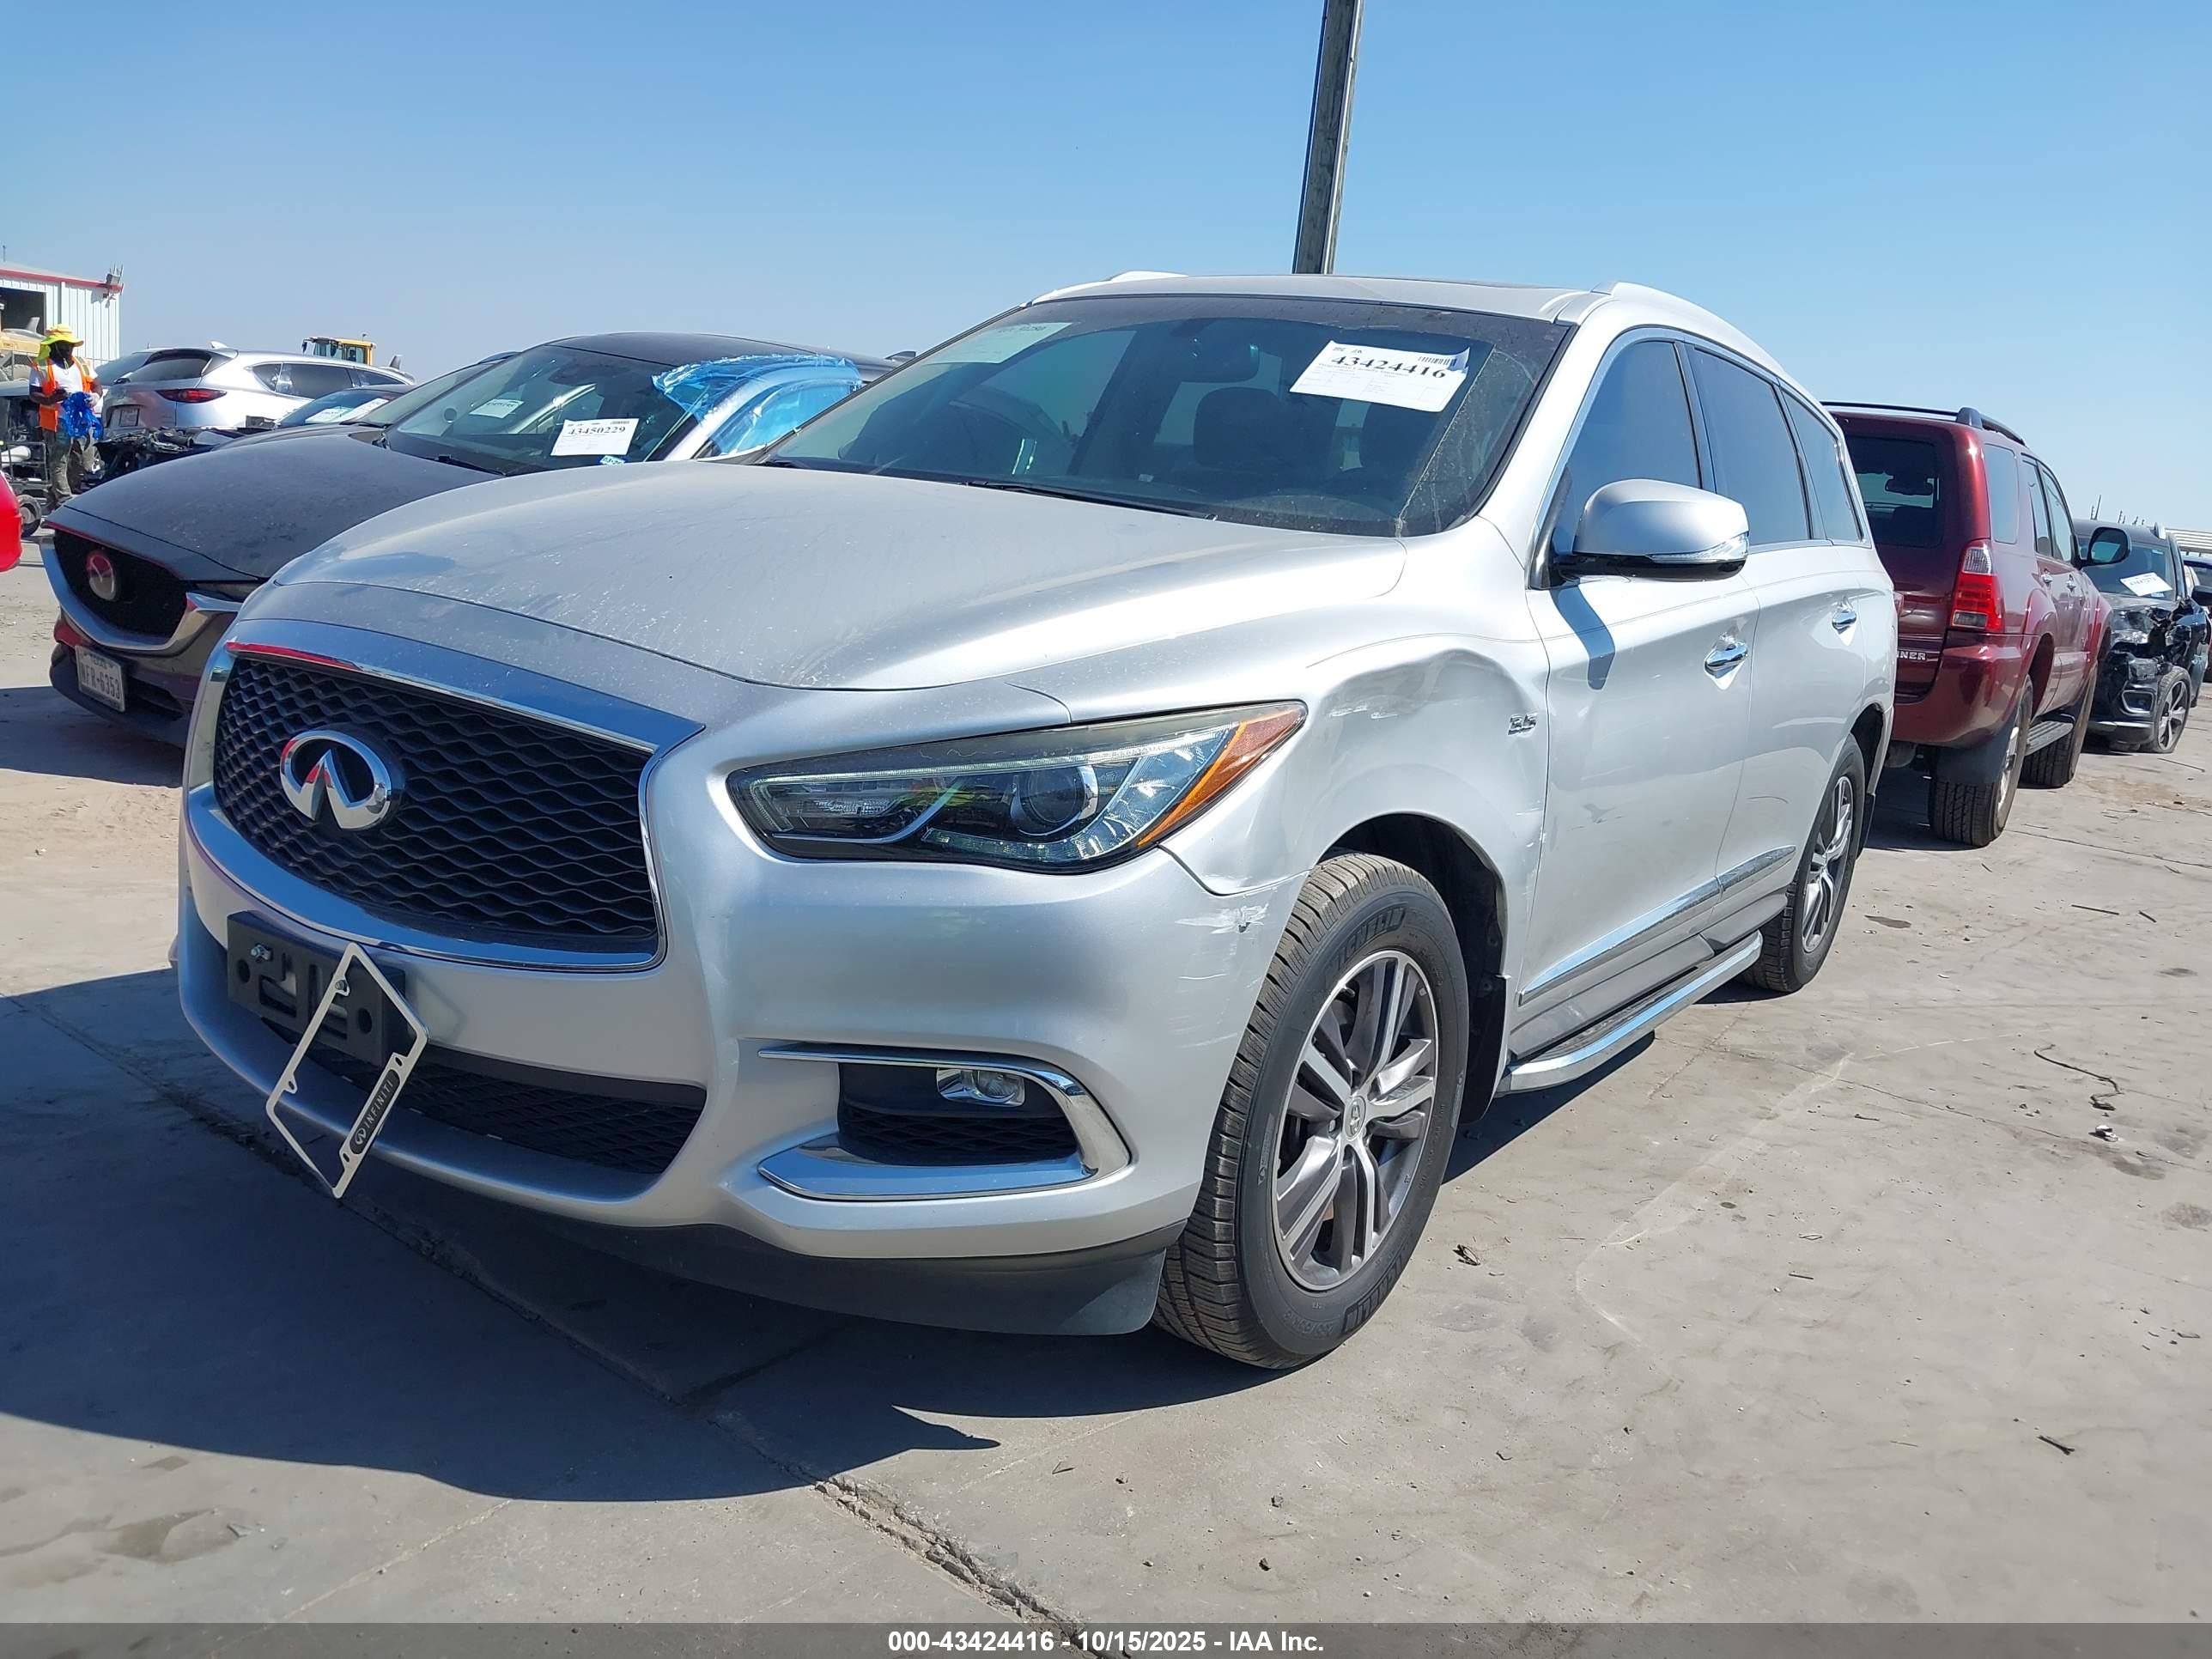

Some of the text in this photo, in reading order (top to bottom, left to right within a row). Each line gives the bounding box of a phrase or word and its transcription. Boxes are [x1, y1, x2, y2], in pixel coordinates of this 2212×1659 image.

[1332, 355, 1447, 379] 43424416
[568, 426, 626, 435] 43450229
[364, 1080, 393, 1128] INFINITI
